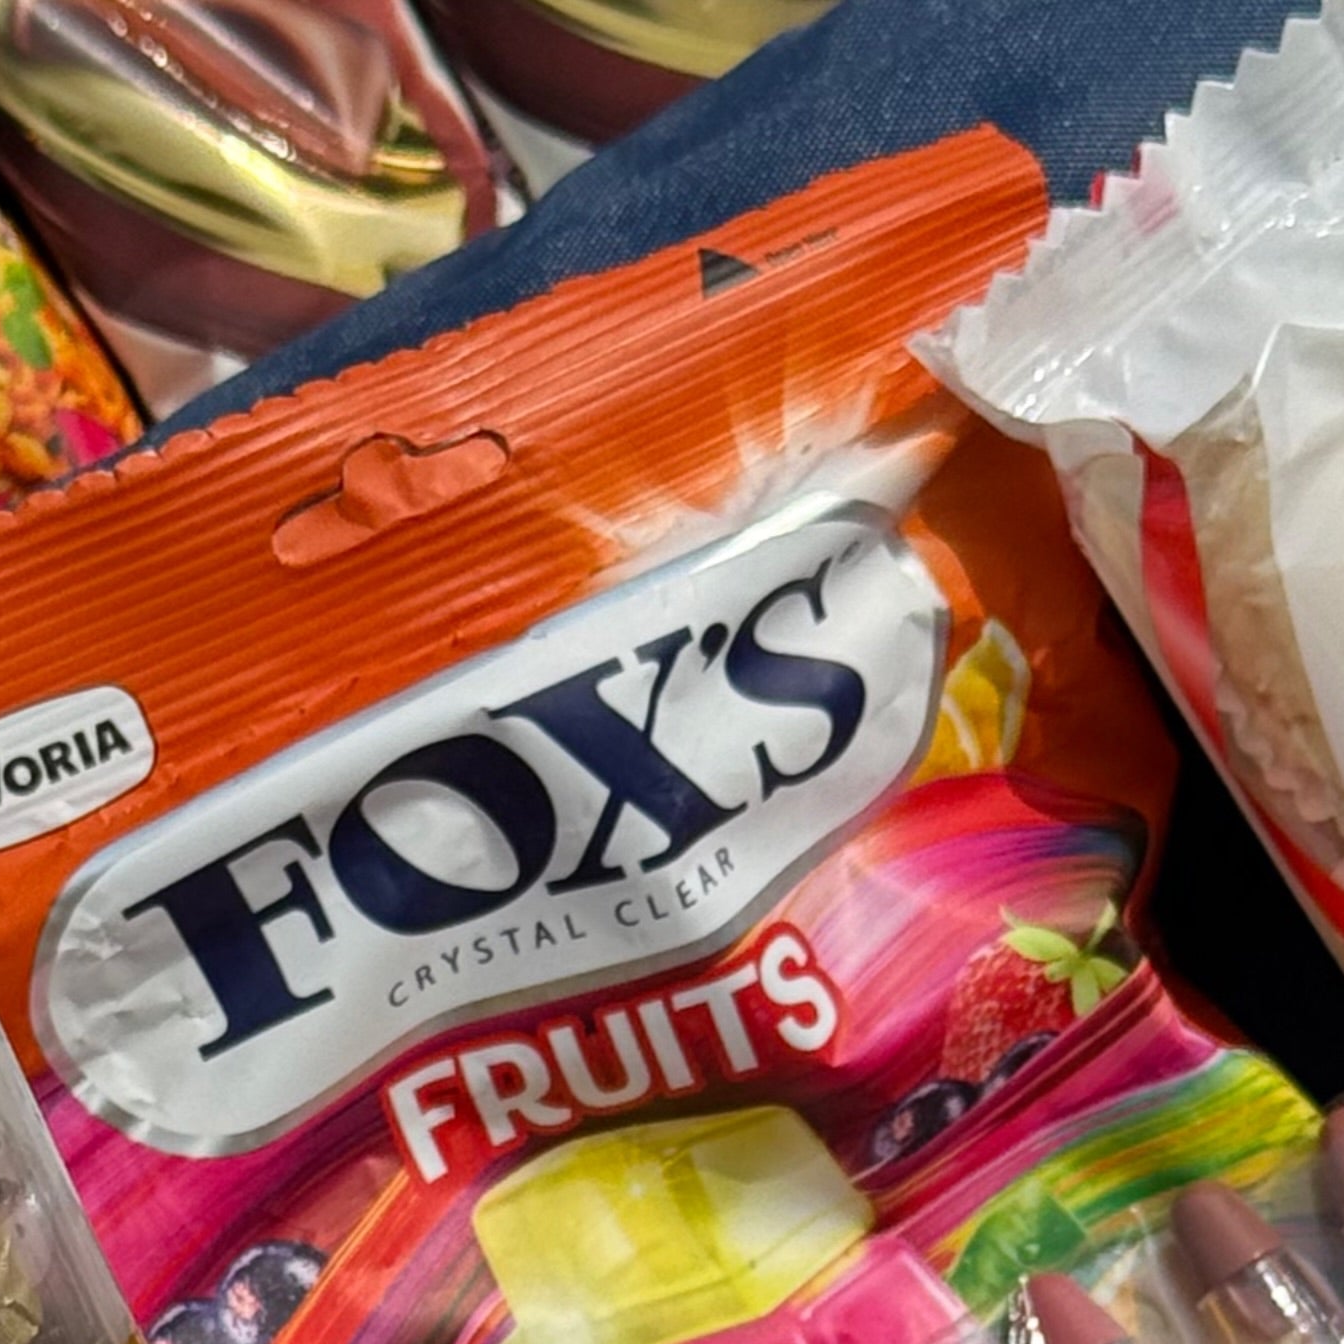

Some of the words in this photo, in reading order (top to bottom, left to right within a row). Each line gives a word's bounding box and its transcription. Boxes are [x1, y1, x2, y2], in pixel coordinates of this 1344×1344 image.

[122, 557, 866, 1062] FOX'S
[387, 918, 586, 1008] CRYSTAL
[614, 845, 736, 928] CLEAR
[389, 938, 840, 1184] FRUITS
